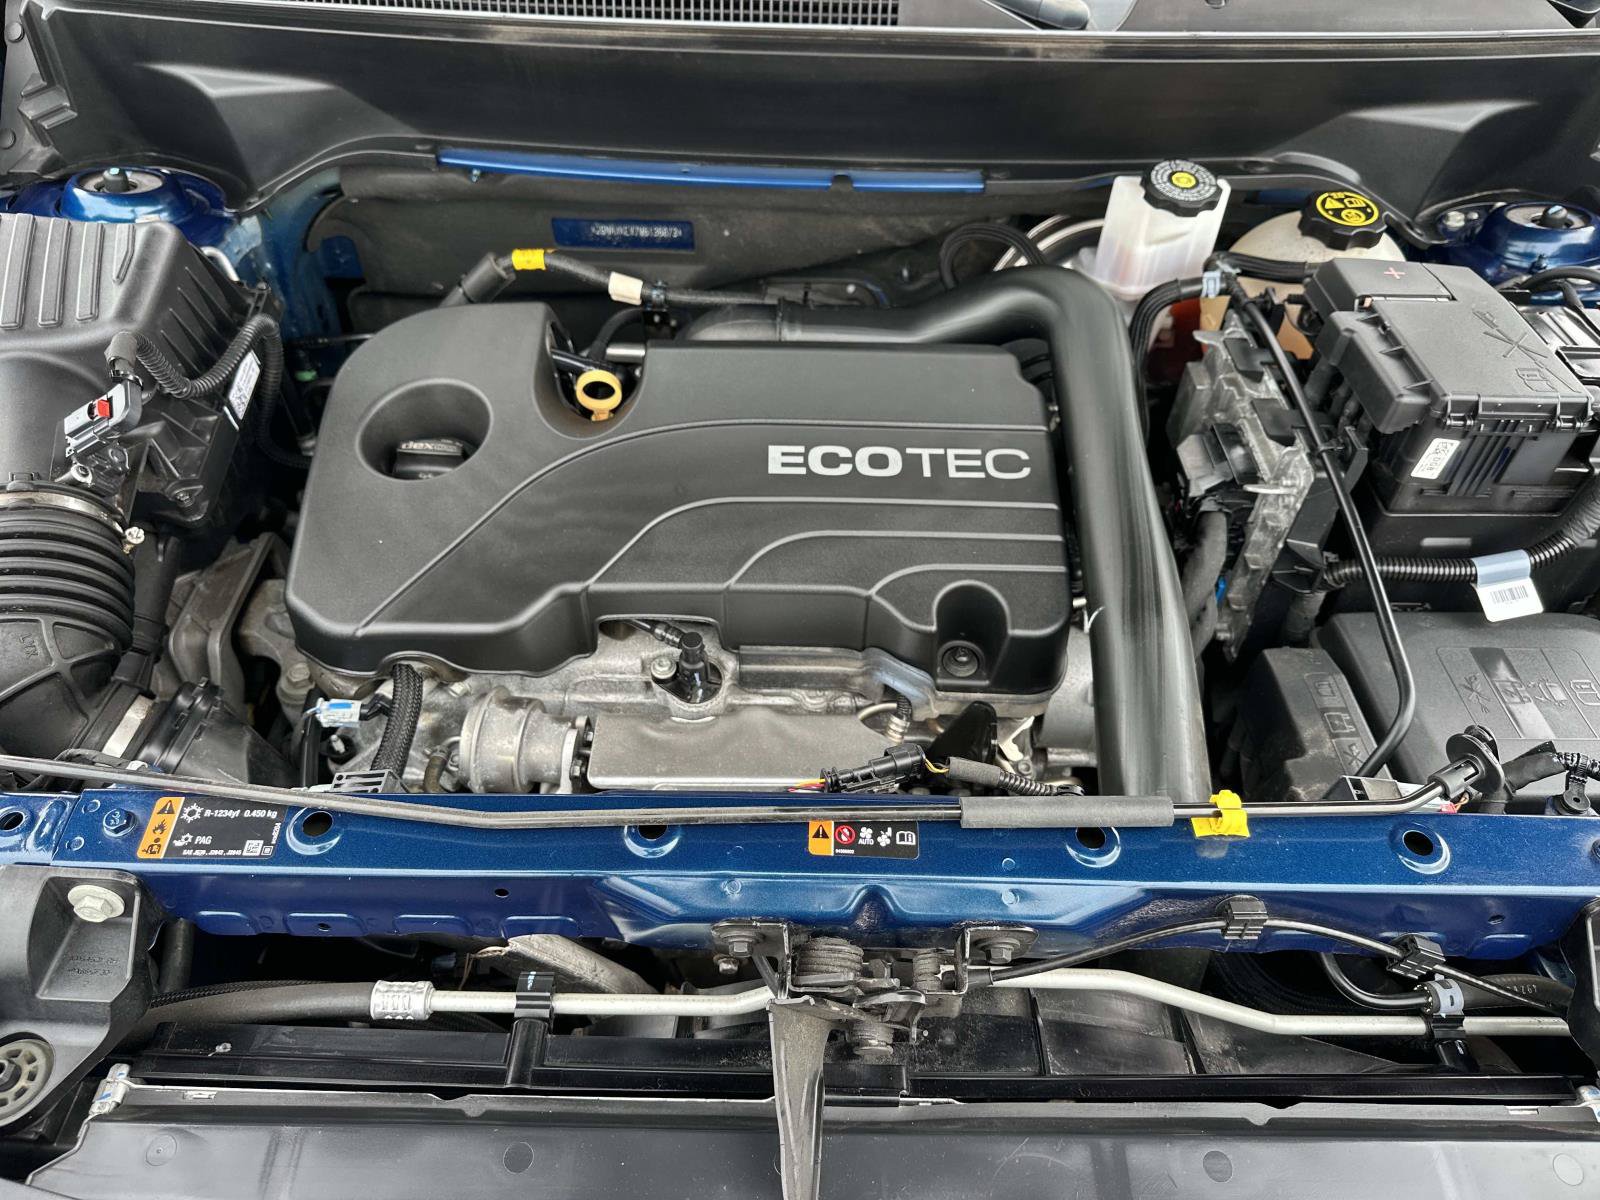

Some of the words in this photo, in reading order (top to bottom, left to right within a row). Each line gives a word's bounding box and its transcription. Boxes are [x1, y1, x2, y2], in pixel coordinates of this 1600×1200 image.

[768, 445, 1031, 480] ECOTEC
[204, 810, 240, 818] R-1234yf
[244, 809, 266, 818] 0.450
[267, 809, 277, 818] kg
[194, 836, 212, 845] PAG
